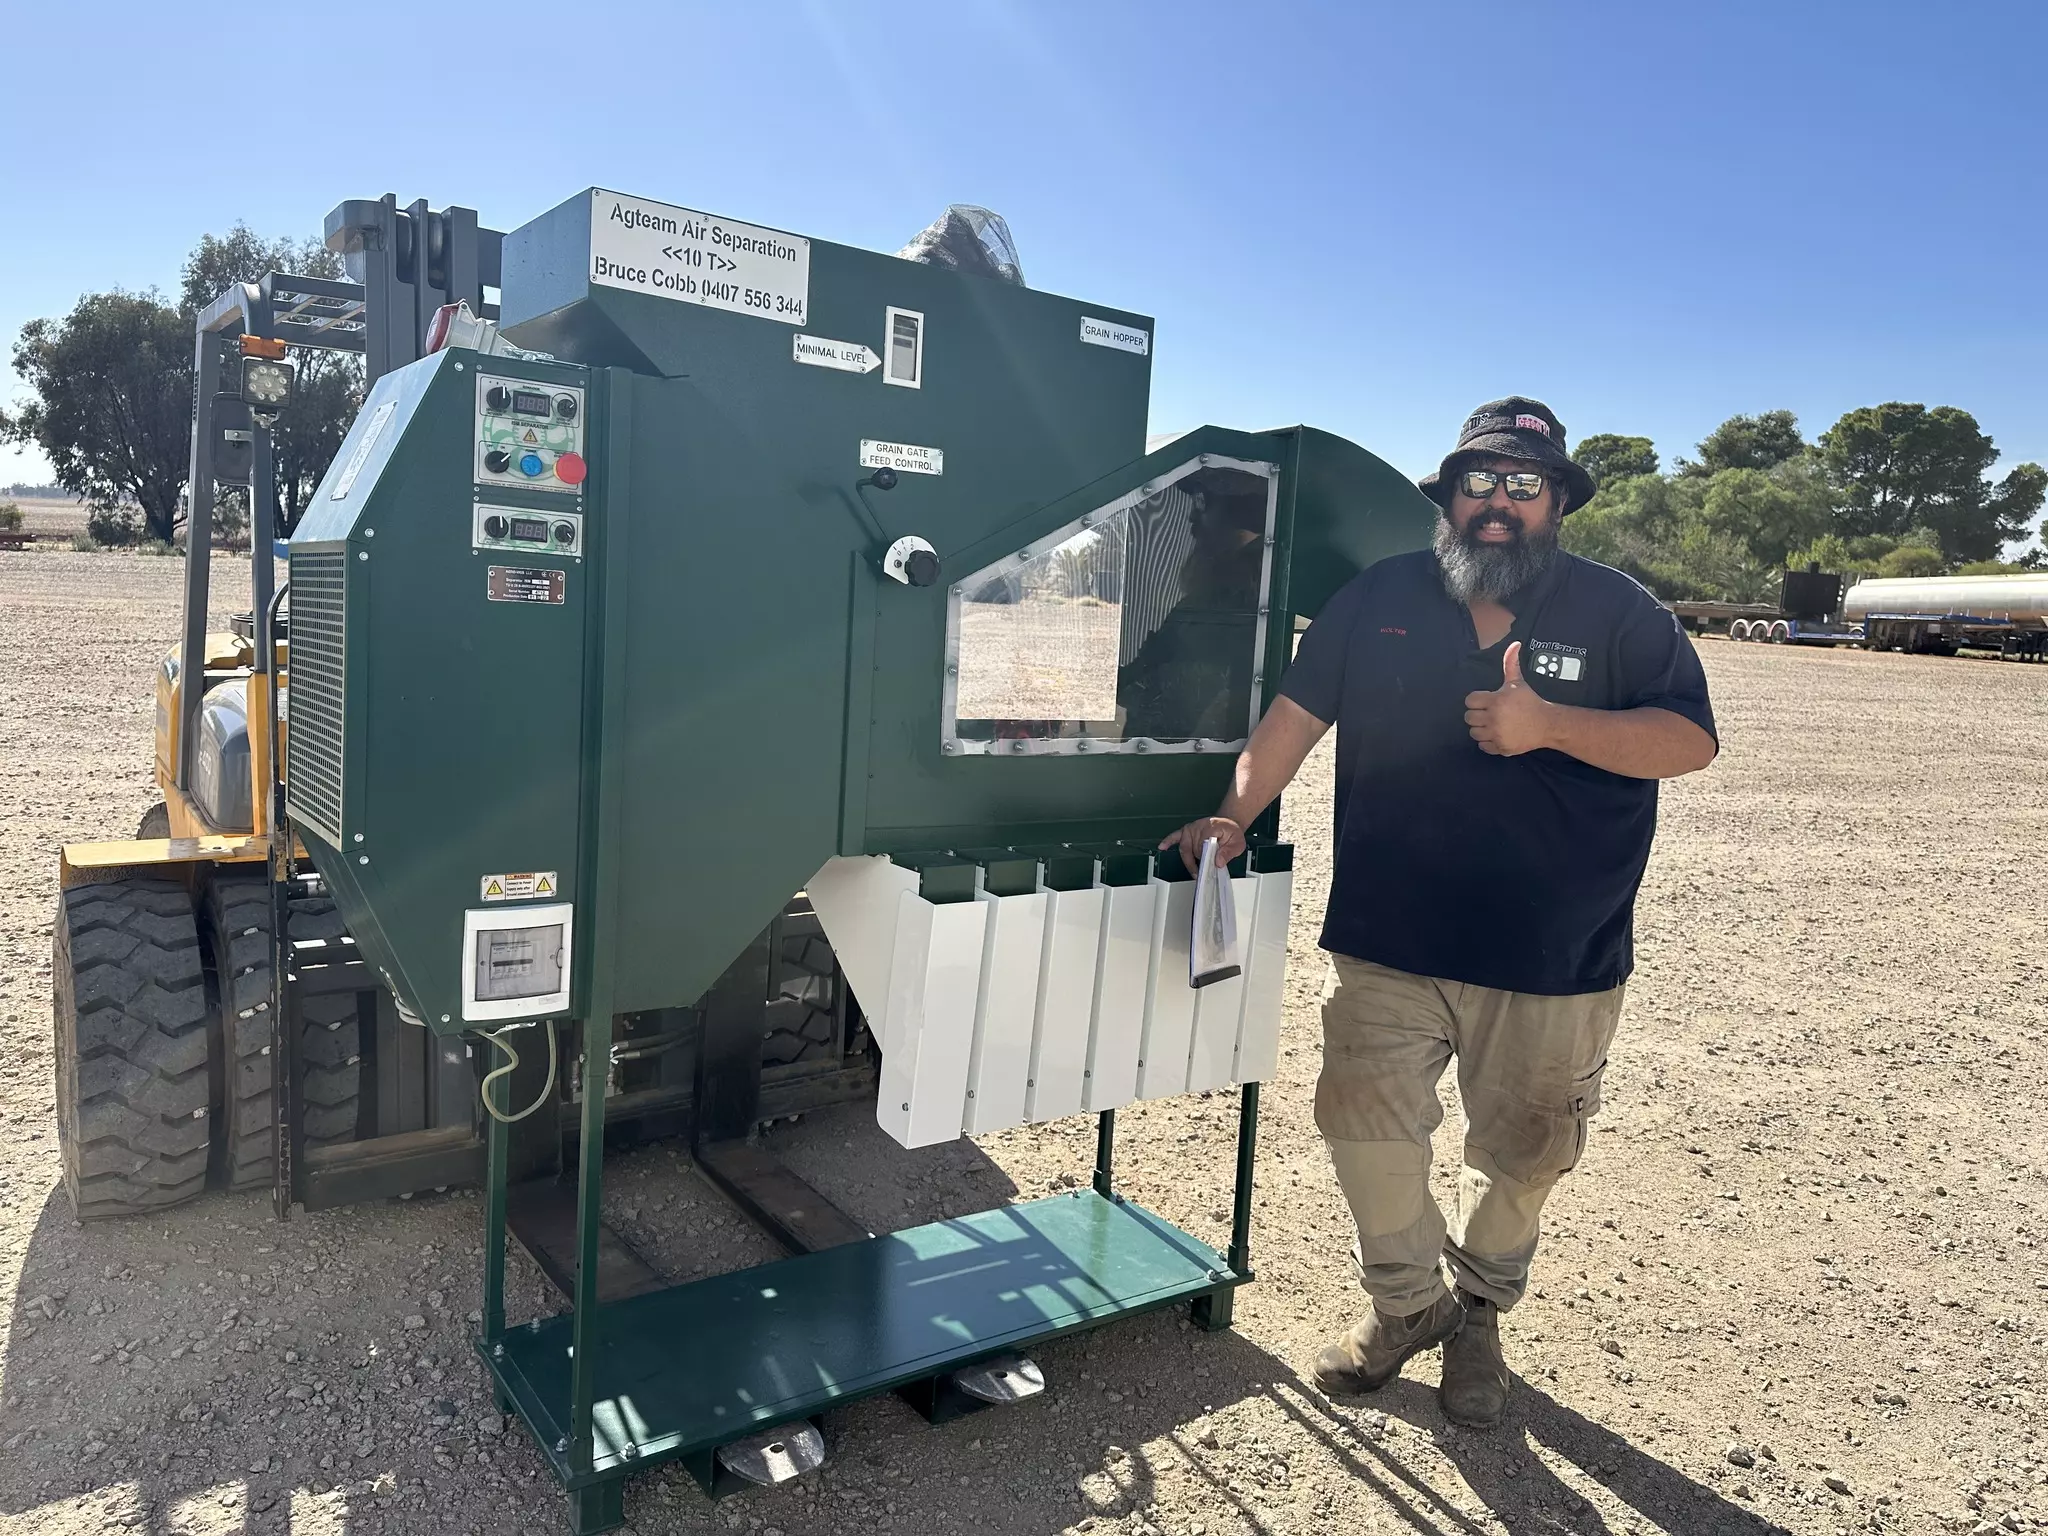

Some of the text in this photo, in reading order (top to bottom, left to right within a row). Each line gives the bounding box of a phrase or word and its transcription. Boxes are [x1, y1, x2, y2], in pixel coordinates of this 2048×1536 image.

[610, 202, 797, 262] Agteam Air Separation
[595, 255, 803, 316] Bruce Cobb 0407 556 344
[1085, 325, 1144, 347] GRAIN HOPPER
[796, 343, 867, 364] MINIMAL LEVEL
[876, 443, 929, 459] GRAIN GATE
[869, 454, 934, 471] FEED CONTROL
[1380, 627, 1407, 636] WOLTER
